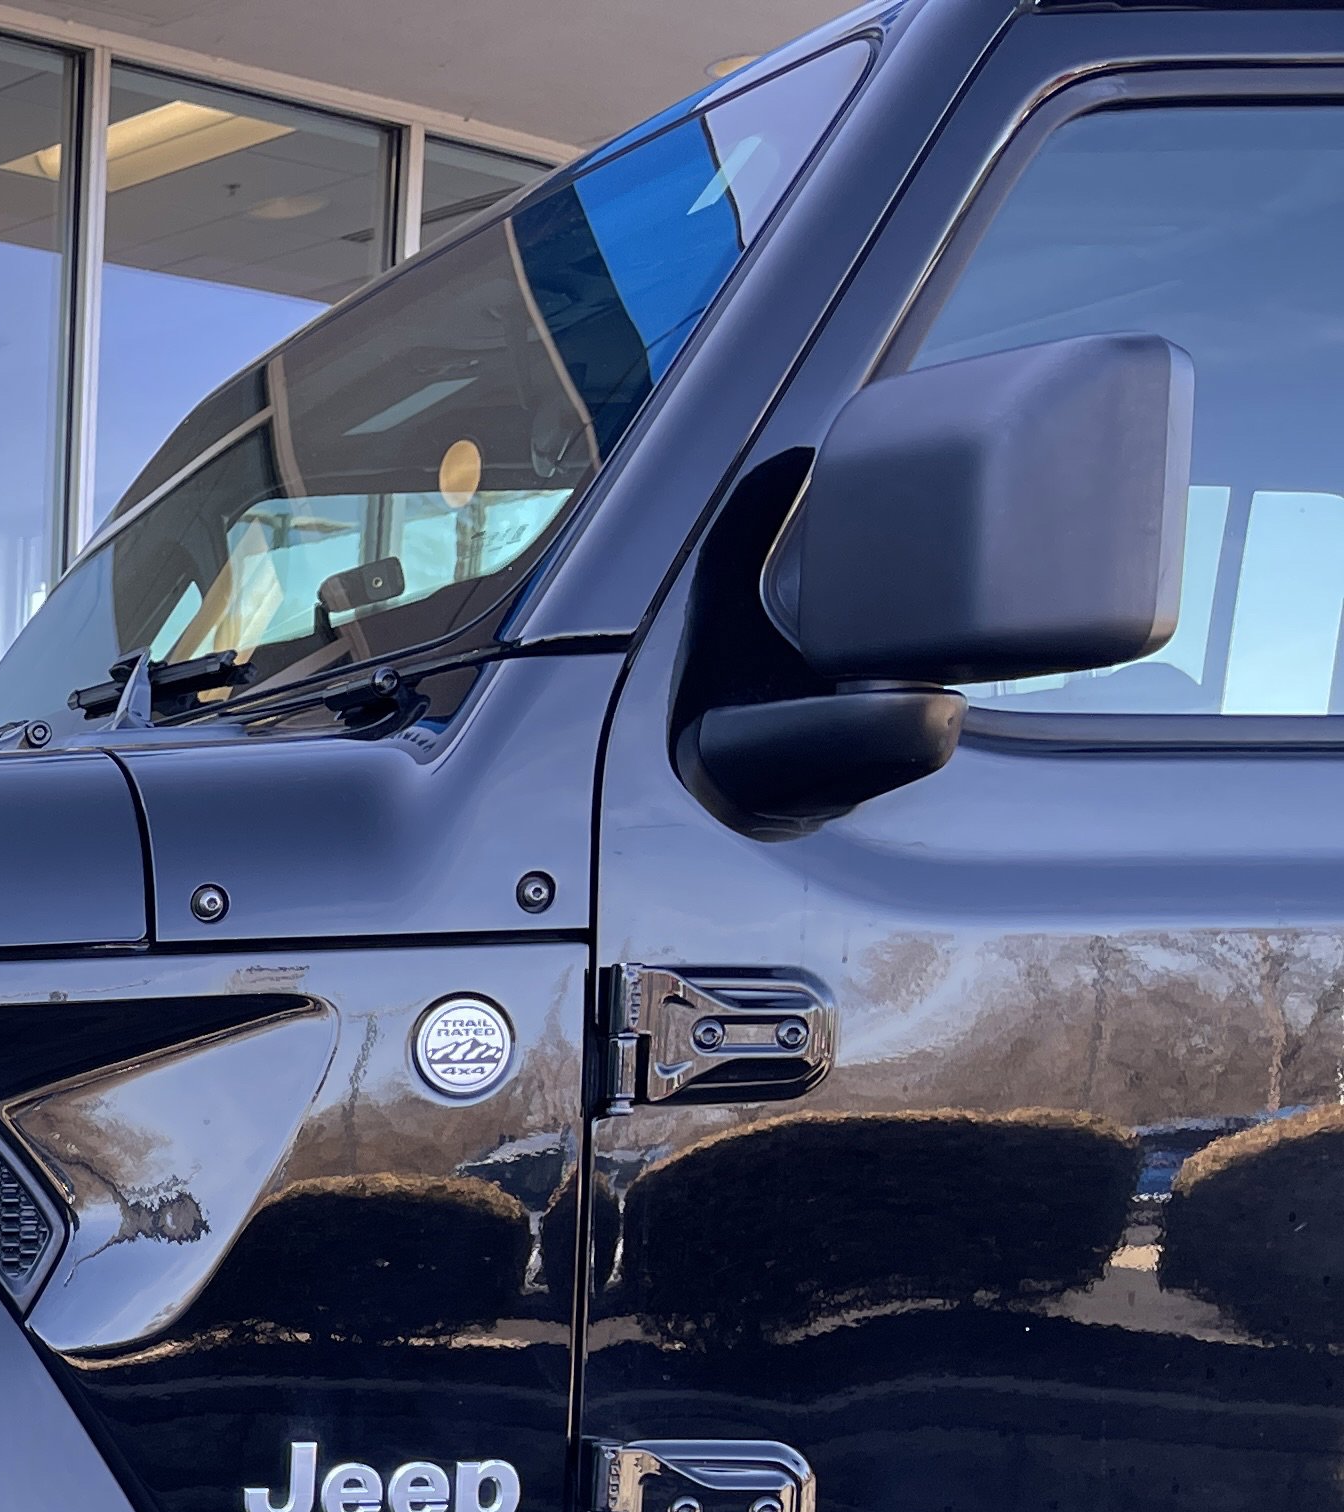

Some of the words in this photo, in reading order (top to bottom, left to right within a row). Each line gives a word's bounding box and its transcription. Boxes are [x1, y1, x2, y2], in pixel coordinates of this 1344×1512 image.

[440, 1019, 492, 1028] TRAIL
[437, 1028, 496, 1037] RATED
[441, 1067, 487, 1076] 4x4
